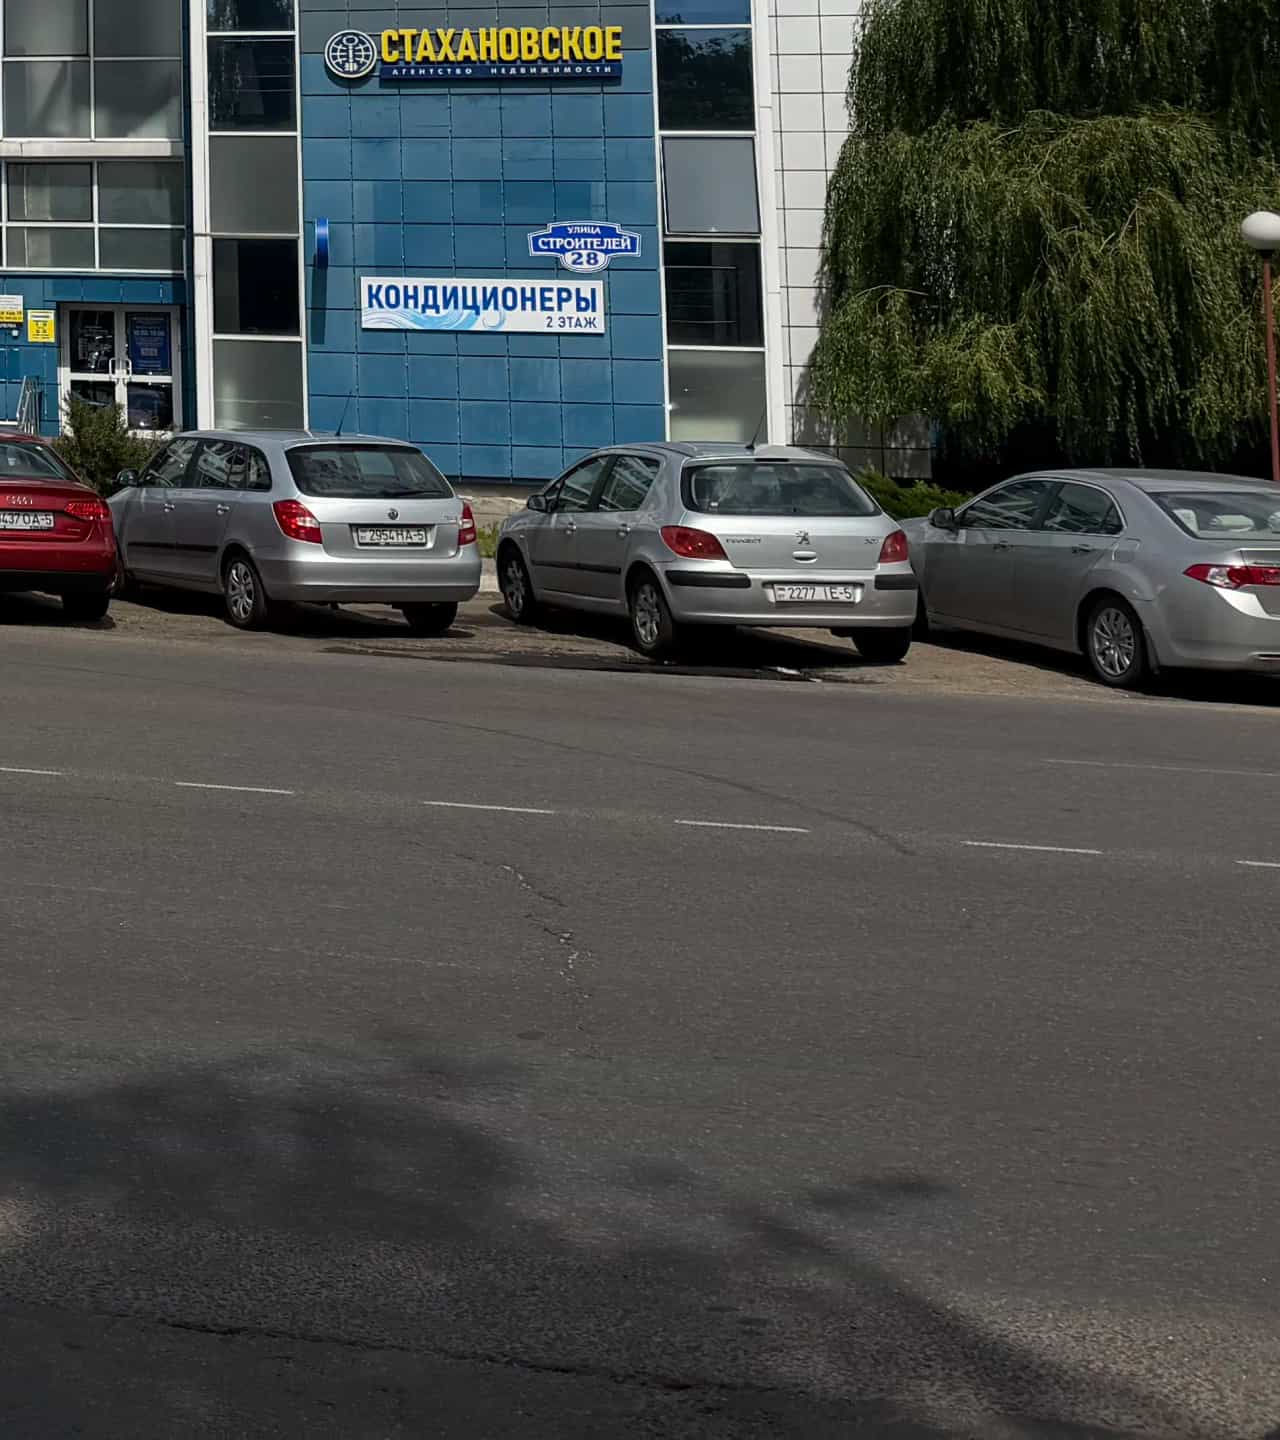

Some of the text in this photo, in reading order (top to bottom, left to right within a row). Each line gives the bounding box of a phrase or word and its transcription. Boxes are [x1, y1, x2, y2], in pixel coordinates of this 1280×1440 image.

[380, 26, 624, 63] СТАХАНОВСКОЕ
[391, 66, 613, 76] АГЕНТСТВО НЕДВИЖИМОСТИ
[566, 225, 601, 235] УЛИЦА
[538, 236, 631, 250] СТРОИТЕЛЕЙ
[571, 252, 599, 266] 28
[366, 283, 598, 316] КОНДИЦИОНЕРЫ
[545, 316, 598, 329] 2 ЭТАЖ
[22, 513, 52, 525] OA-5
[369, 529, 394, 541] 2954
[789, 587, 815, 599] 2277
